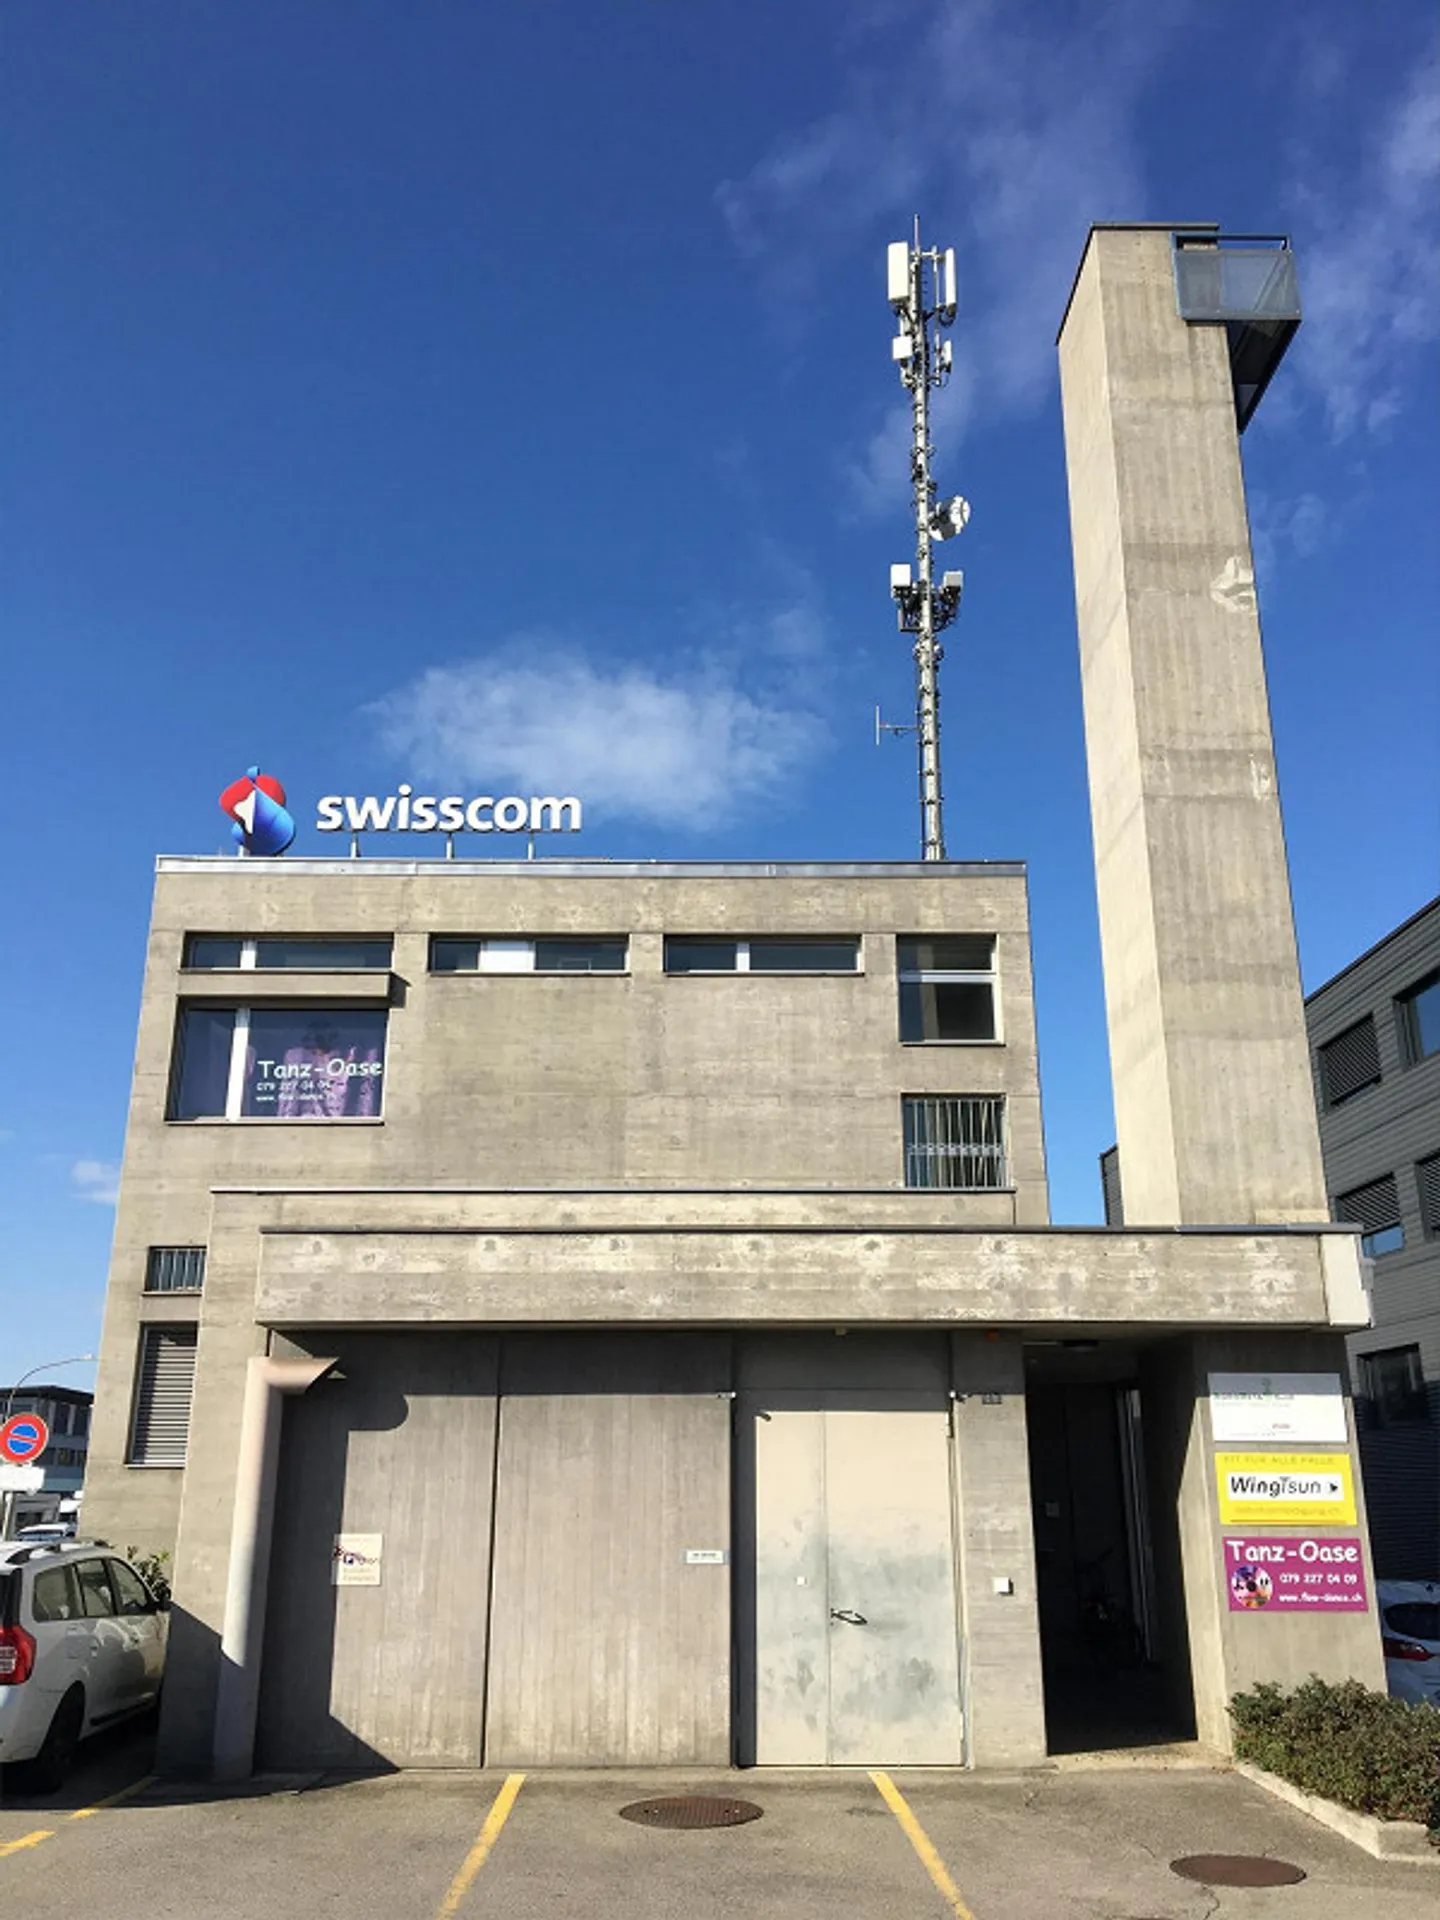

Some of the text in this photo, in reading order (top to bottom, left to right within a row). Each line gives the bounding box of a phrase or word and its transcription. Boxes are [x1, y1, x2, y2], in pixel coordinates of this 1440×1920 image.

[316, 784, 582, 832] swisscom
[257, 1058, 383, 1079] Tanz-Oase
[1231, 1476, 1322, 1498] WingTsun
[1226, 1541, 1359, 1562] Tanz-Oase
